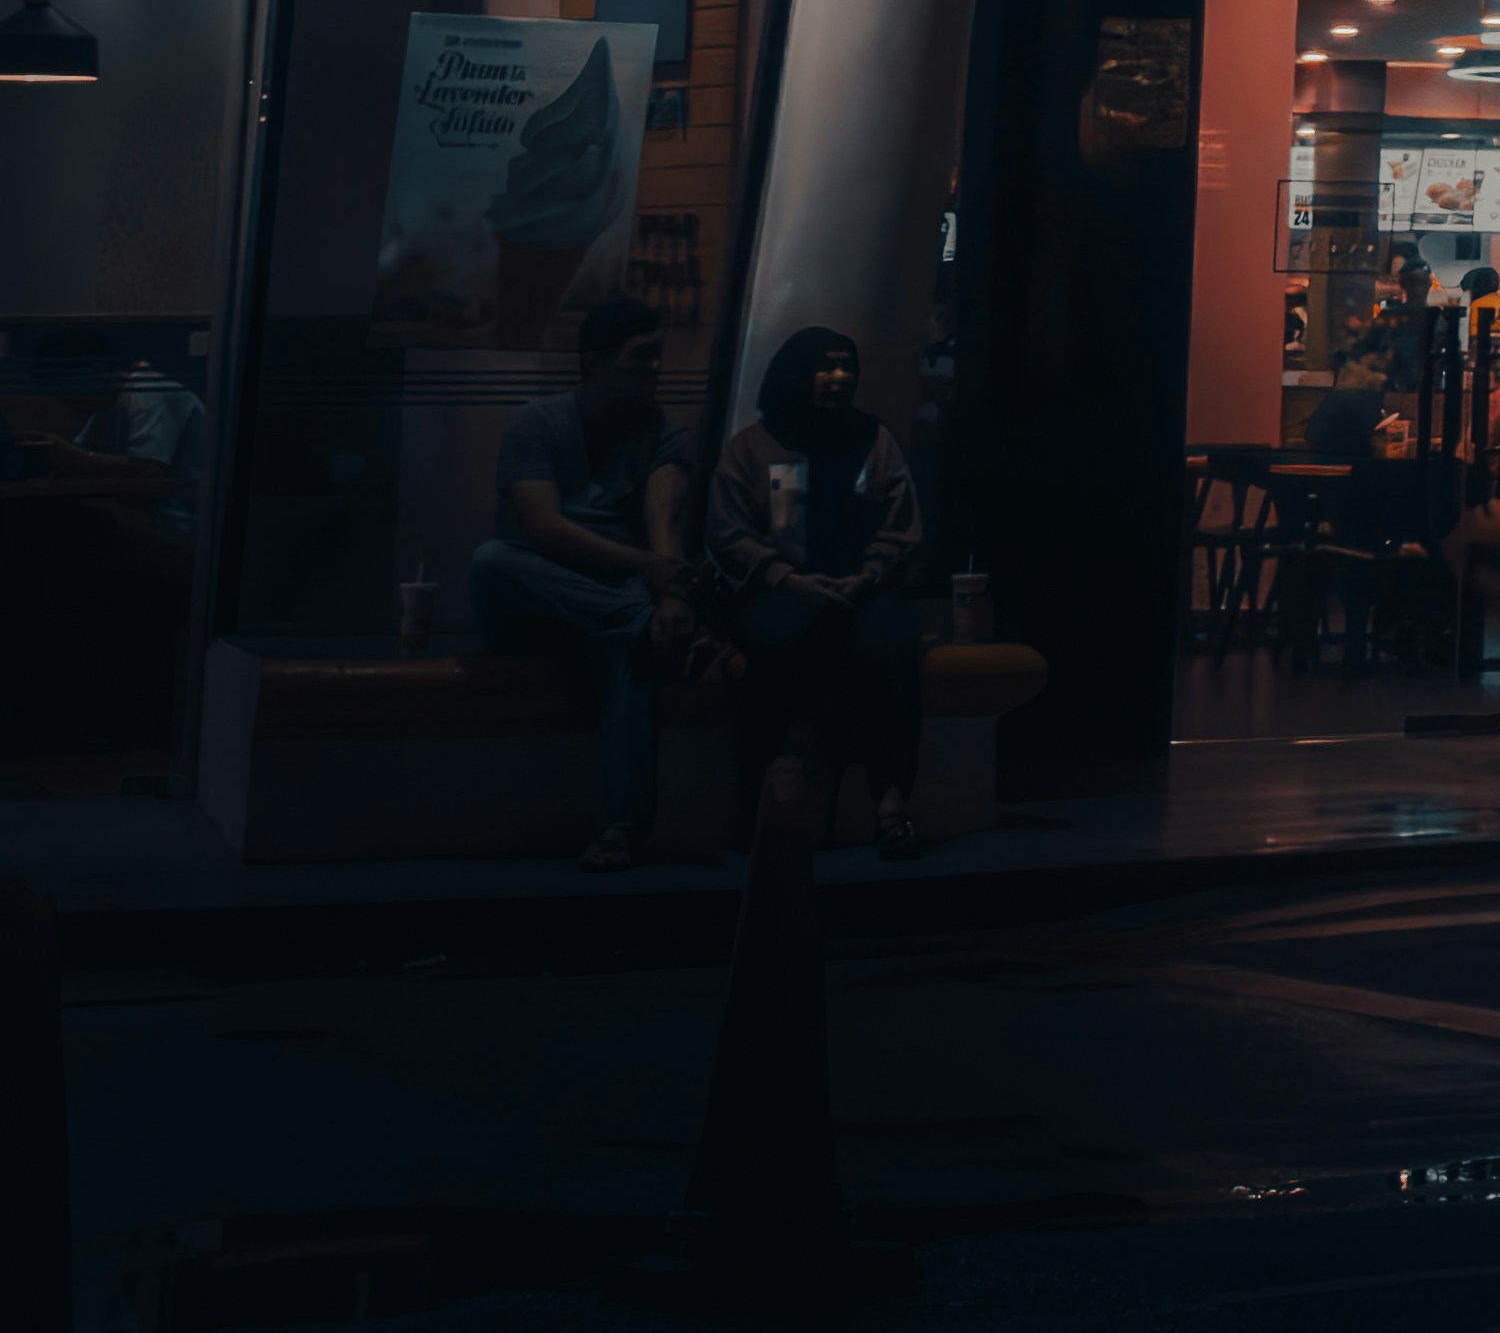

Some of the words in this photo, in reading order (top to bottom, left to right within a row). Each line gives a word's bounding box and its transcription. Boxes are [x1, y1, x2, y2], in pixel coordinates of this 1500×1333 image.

[434, 50, 507, 81] Plum
[414, 71, 535, 113] Lavender
[1294, 210, 1310, 226] 24
